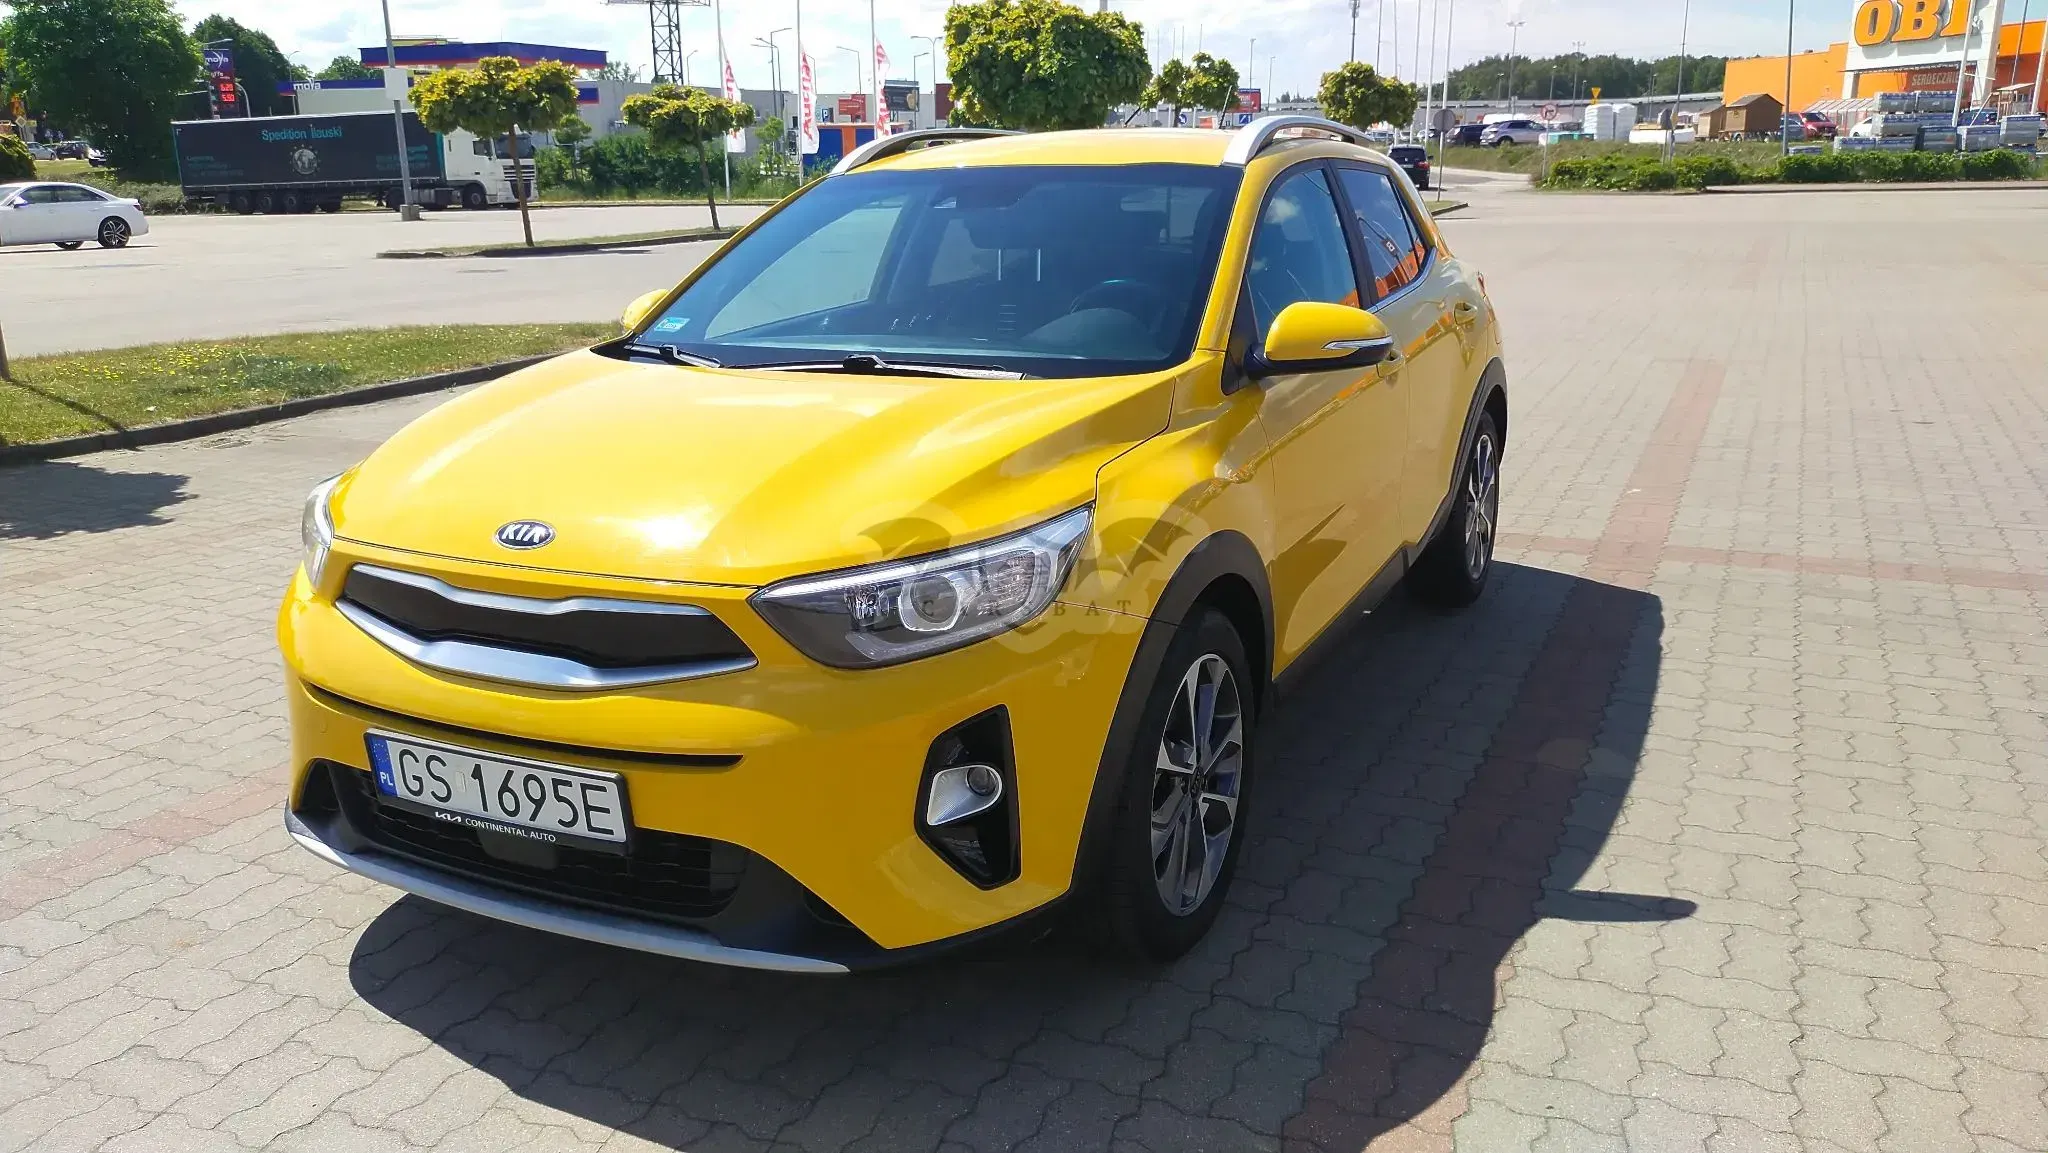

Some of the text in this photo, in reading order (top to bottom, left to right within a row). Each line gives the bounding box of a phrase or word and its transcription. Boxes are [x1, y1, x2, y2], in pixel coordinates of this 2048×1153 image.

[1854, 0, 1971, 46] OBI
[262, 129, 307, 143] Spedition
[501, 523, 546, 544] KIA
[380, 771, 394, 787] PL
[398, 748, 616, 836] GS 1695E
[465, 818, 528, 838] CONTINENTAL
[529, 831, 556, 843] AUTO
